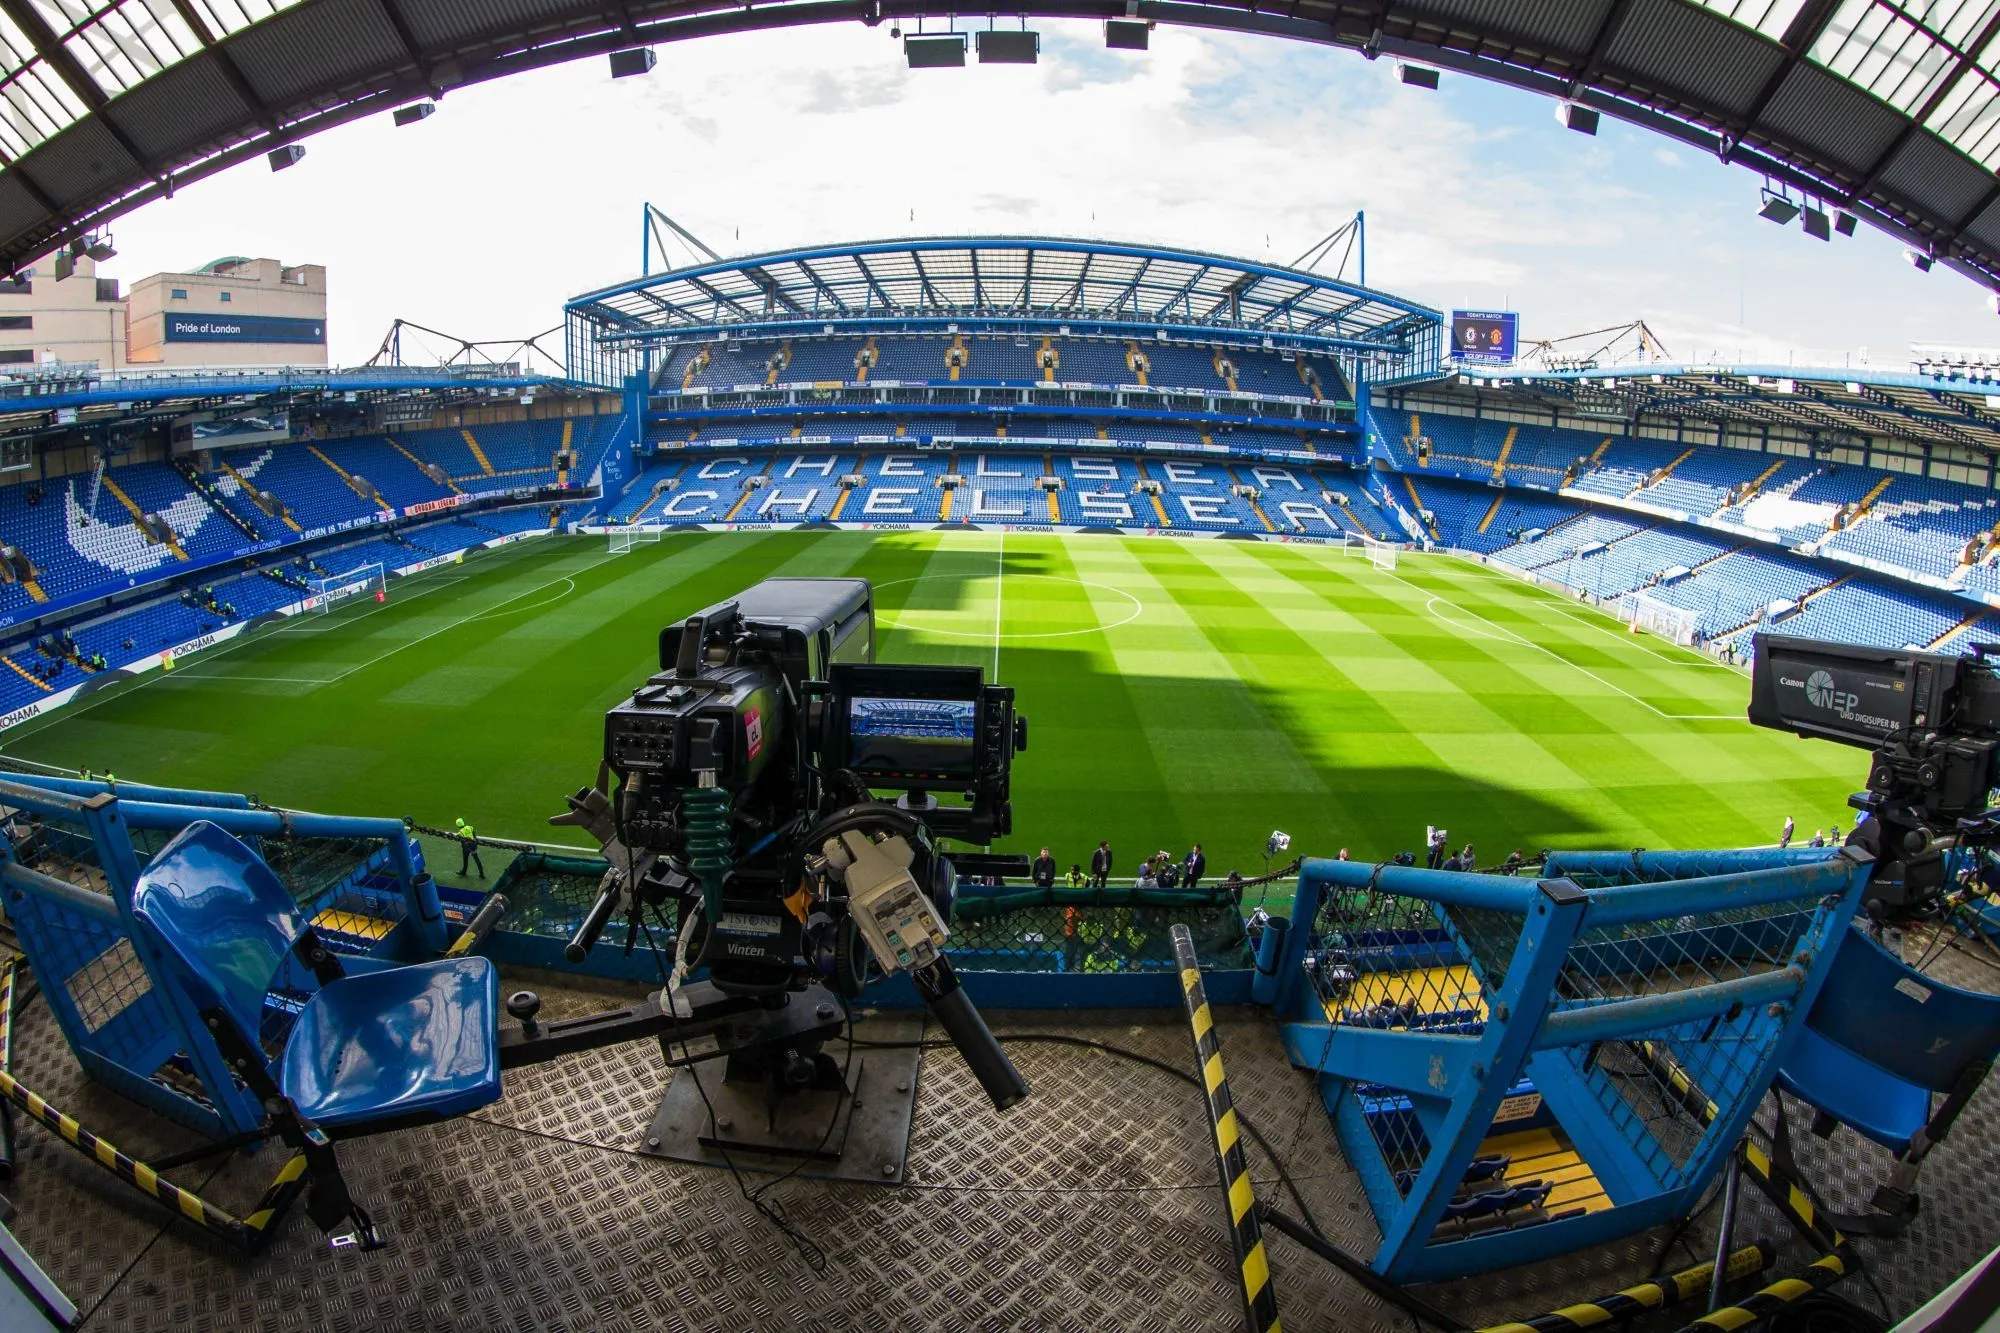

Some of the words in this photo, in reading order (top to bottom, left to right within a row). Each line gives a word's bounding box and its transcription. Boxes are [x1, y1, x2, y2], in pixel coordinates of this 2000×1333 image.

[175, 322, 199, 333] Pride
[200, 323, 209, 333] of
[210, 324, 241, 335] London
[437, 498, 456, 510] LEGEND
[305, 526, 327, 540] BORN
[328, 523, 336, 535] IS
[337, 519, 353, 531] THE
[353, 514, 371, 527] KING
[1015, 525, 1055, 533] YOKOHAMA
[1157, 529, 1196, 538] YOKOHAMA
[1291, 536, 1326, 545] YOKOHAMA
[233, 546, 250, 558] PRIDE
[250, 543, 259, 553] OF
[259, 539, 281, 550] LONDON
[1428, 545, 1448, 555] HAMA
[315, 587, 348, 605] YOOHAMA
[171, 634, 216, 658] YOKOHAMA
[1780, 676, 1805, 689] Canon
[1855, 713, 1889, 729] DIGISUPER
[1890, 720, 1900, 731] 86
[727, 943, 766, 957] Vinten
